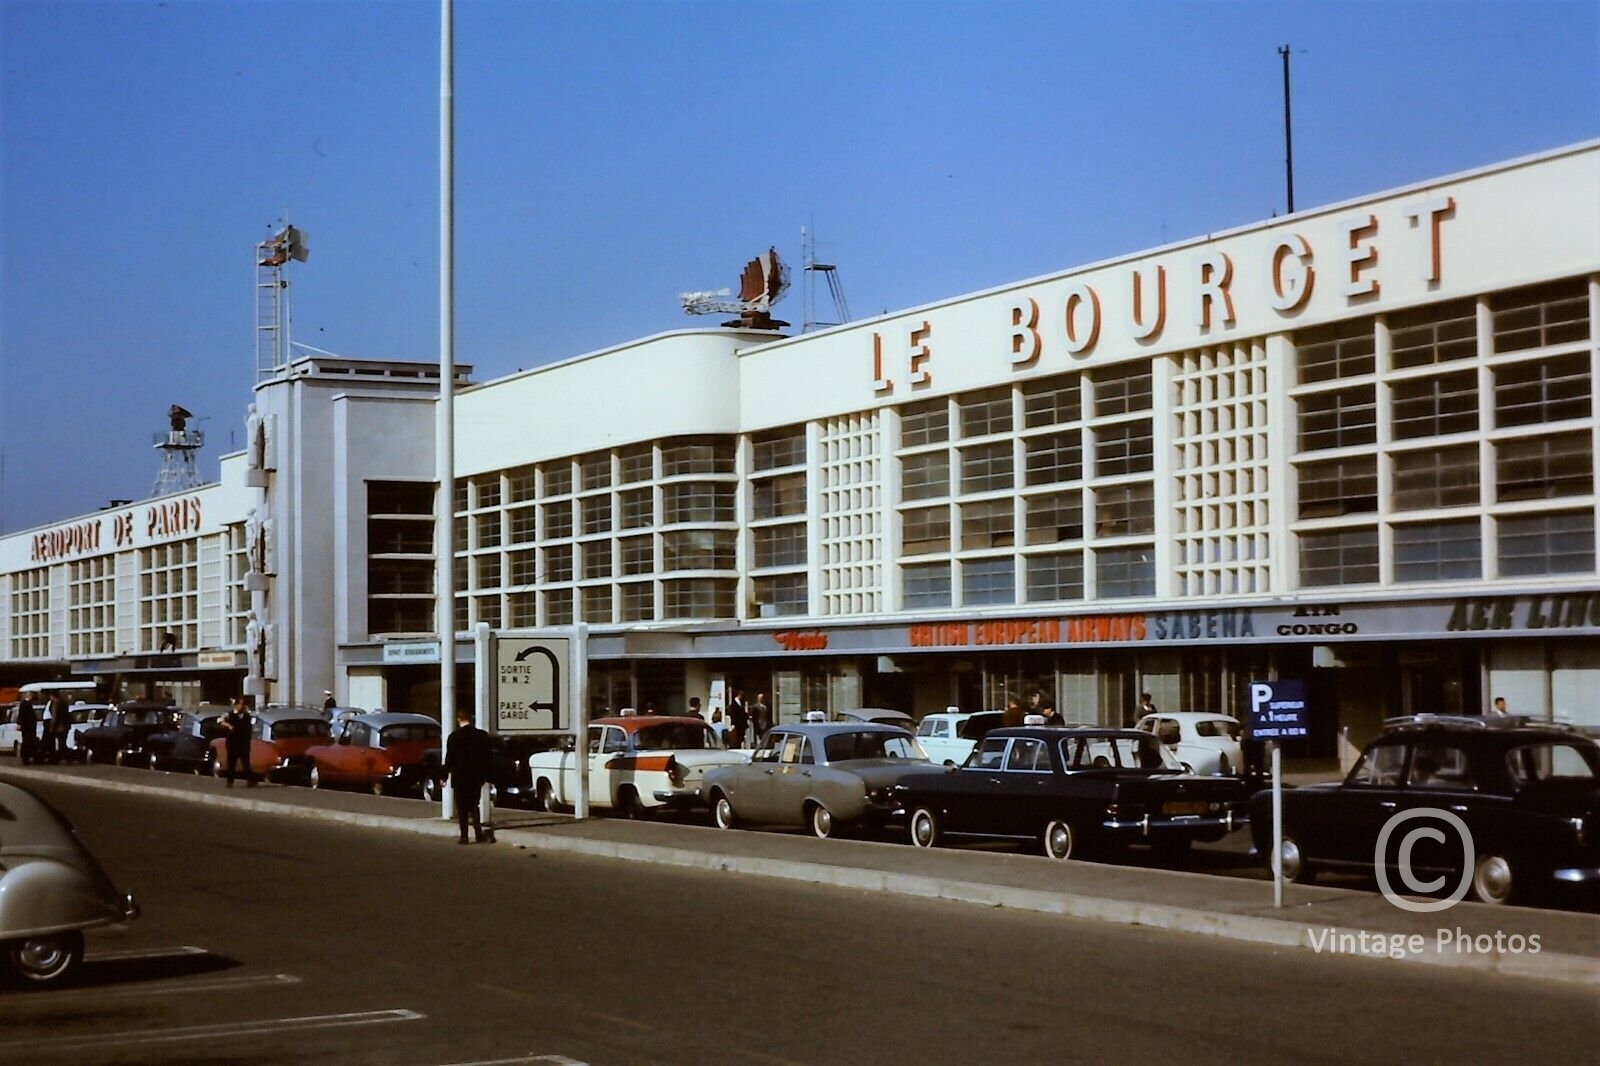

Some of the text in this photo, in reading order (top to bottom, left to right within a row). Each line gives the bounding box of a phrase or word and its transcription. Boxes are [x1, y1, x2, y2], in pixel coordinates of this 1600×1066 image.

[867, 196, 1456, 396] LE BOURGET
[31, 496, 201, 561] AEROPORT DE PARIS
[1155, 610, 1255, 640] SABENA
[1276, 622, 1358, 636] CONGO
[1446, 597, 1517, 631] AER
[909, 614, 1146, 646] BRITISH EUROPEAN AIRWAYS
[500, 665, 531, 674] SORTIE
[500, 701, 524, 710] PARC
[1251, 684, 1273, 713] P
